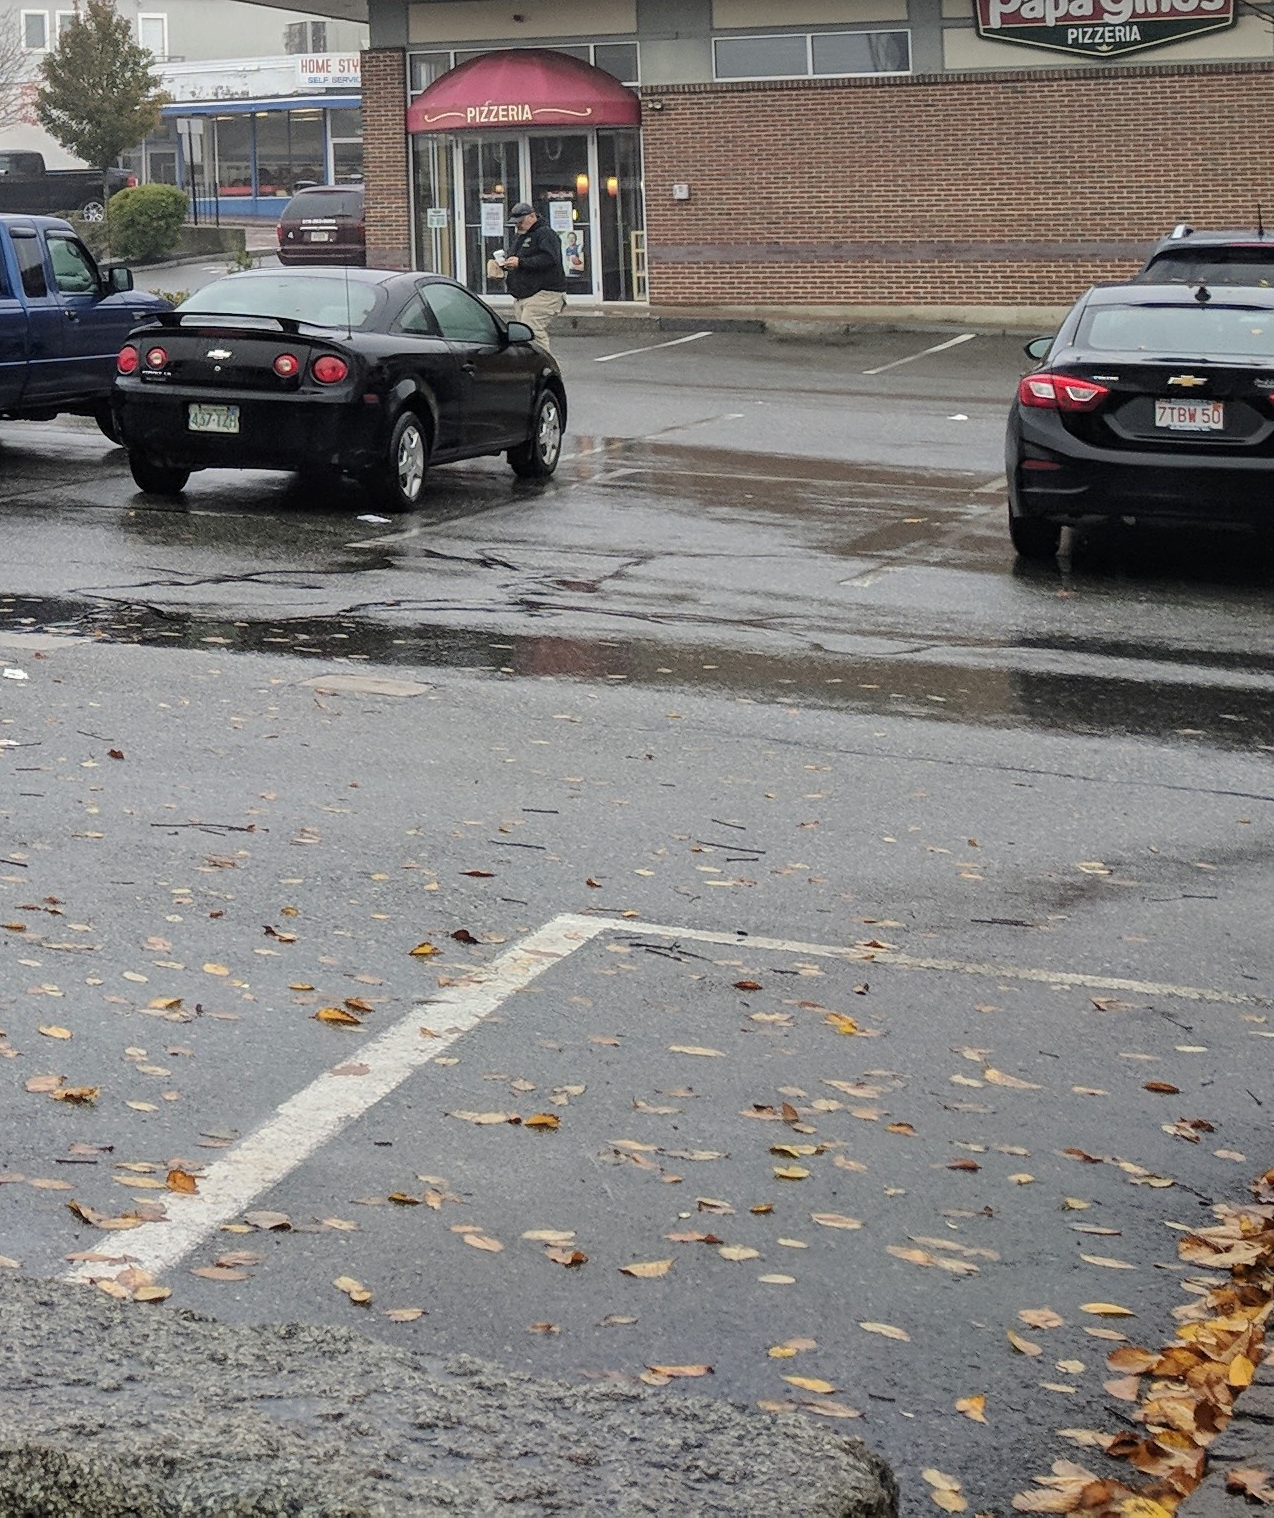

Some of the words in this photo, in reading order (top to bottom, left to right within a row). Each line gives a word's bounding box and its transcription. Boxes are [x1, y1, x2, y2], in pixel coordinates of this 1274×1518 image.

[1067, 25, 1141, 44] PIZZERIA
[301, 59, 331, 73] HOME
[338, 59, 359, 73] STY
[467, 104, 532, 123] PIZZERIA
[1158, 406, 1197, 424] 7TBW
[1203, 408, 1221, 424] 50
